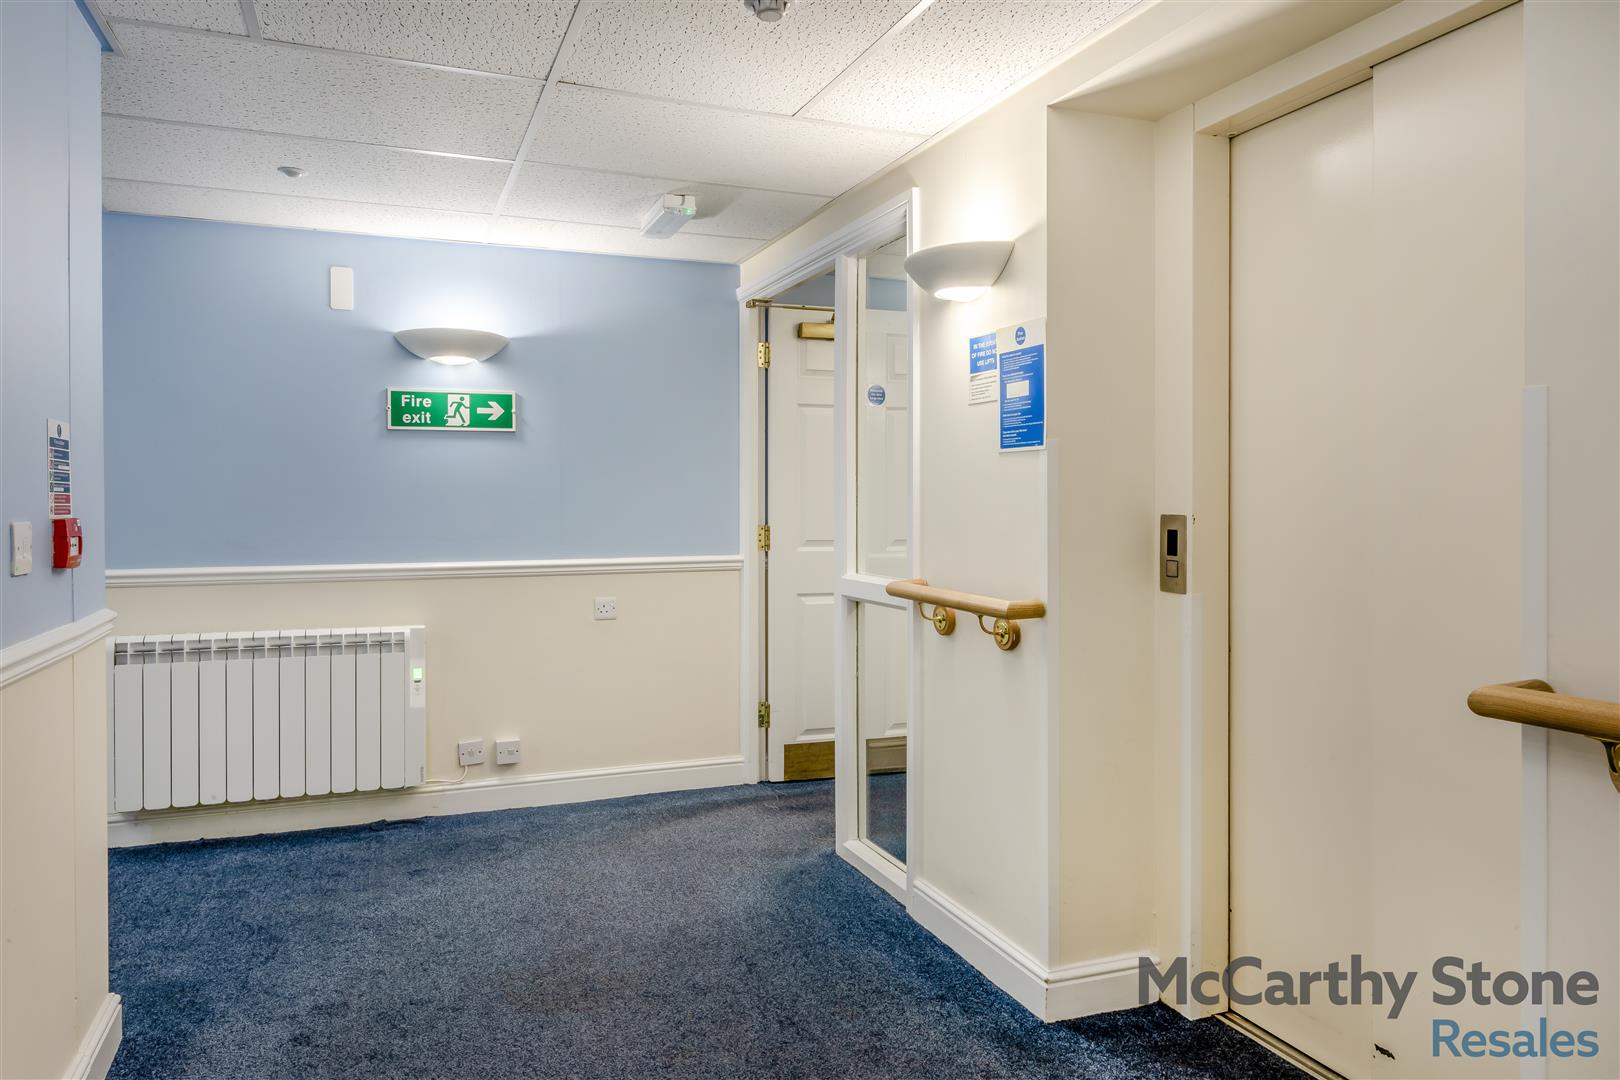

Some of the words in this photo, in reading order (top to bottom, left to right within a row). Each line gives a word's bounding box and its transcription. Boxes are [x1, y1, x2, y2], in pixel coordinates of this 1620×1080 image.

[977, 350, 986, 358] FIRE
[976, 359, 985, 367] USE
[401, 394, 432, 408] Fire
[402, 411, 432, 424] exit
